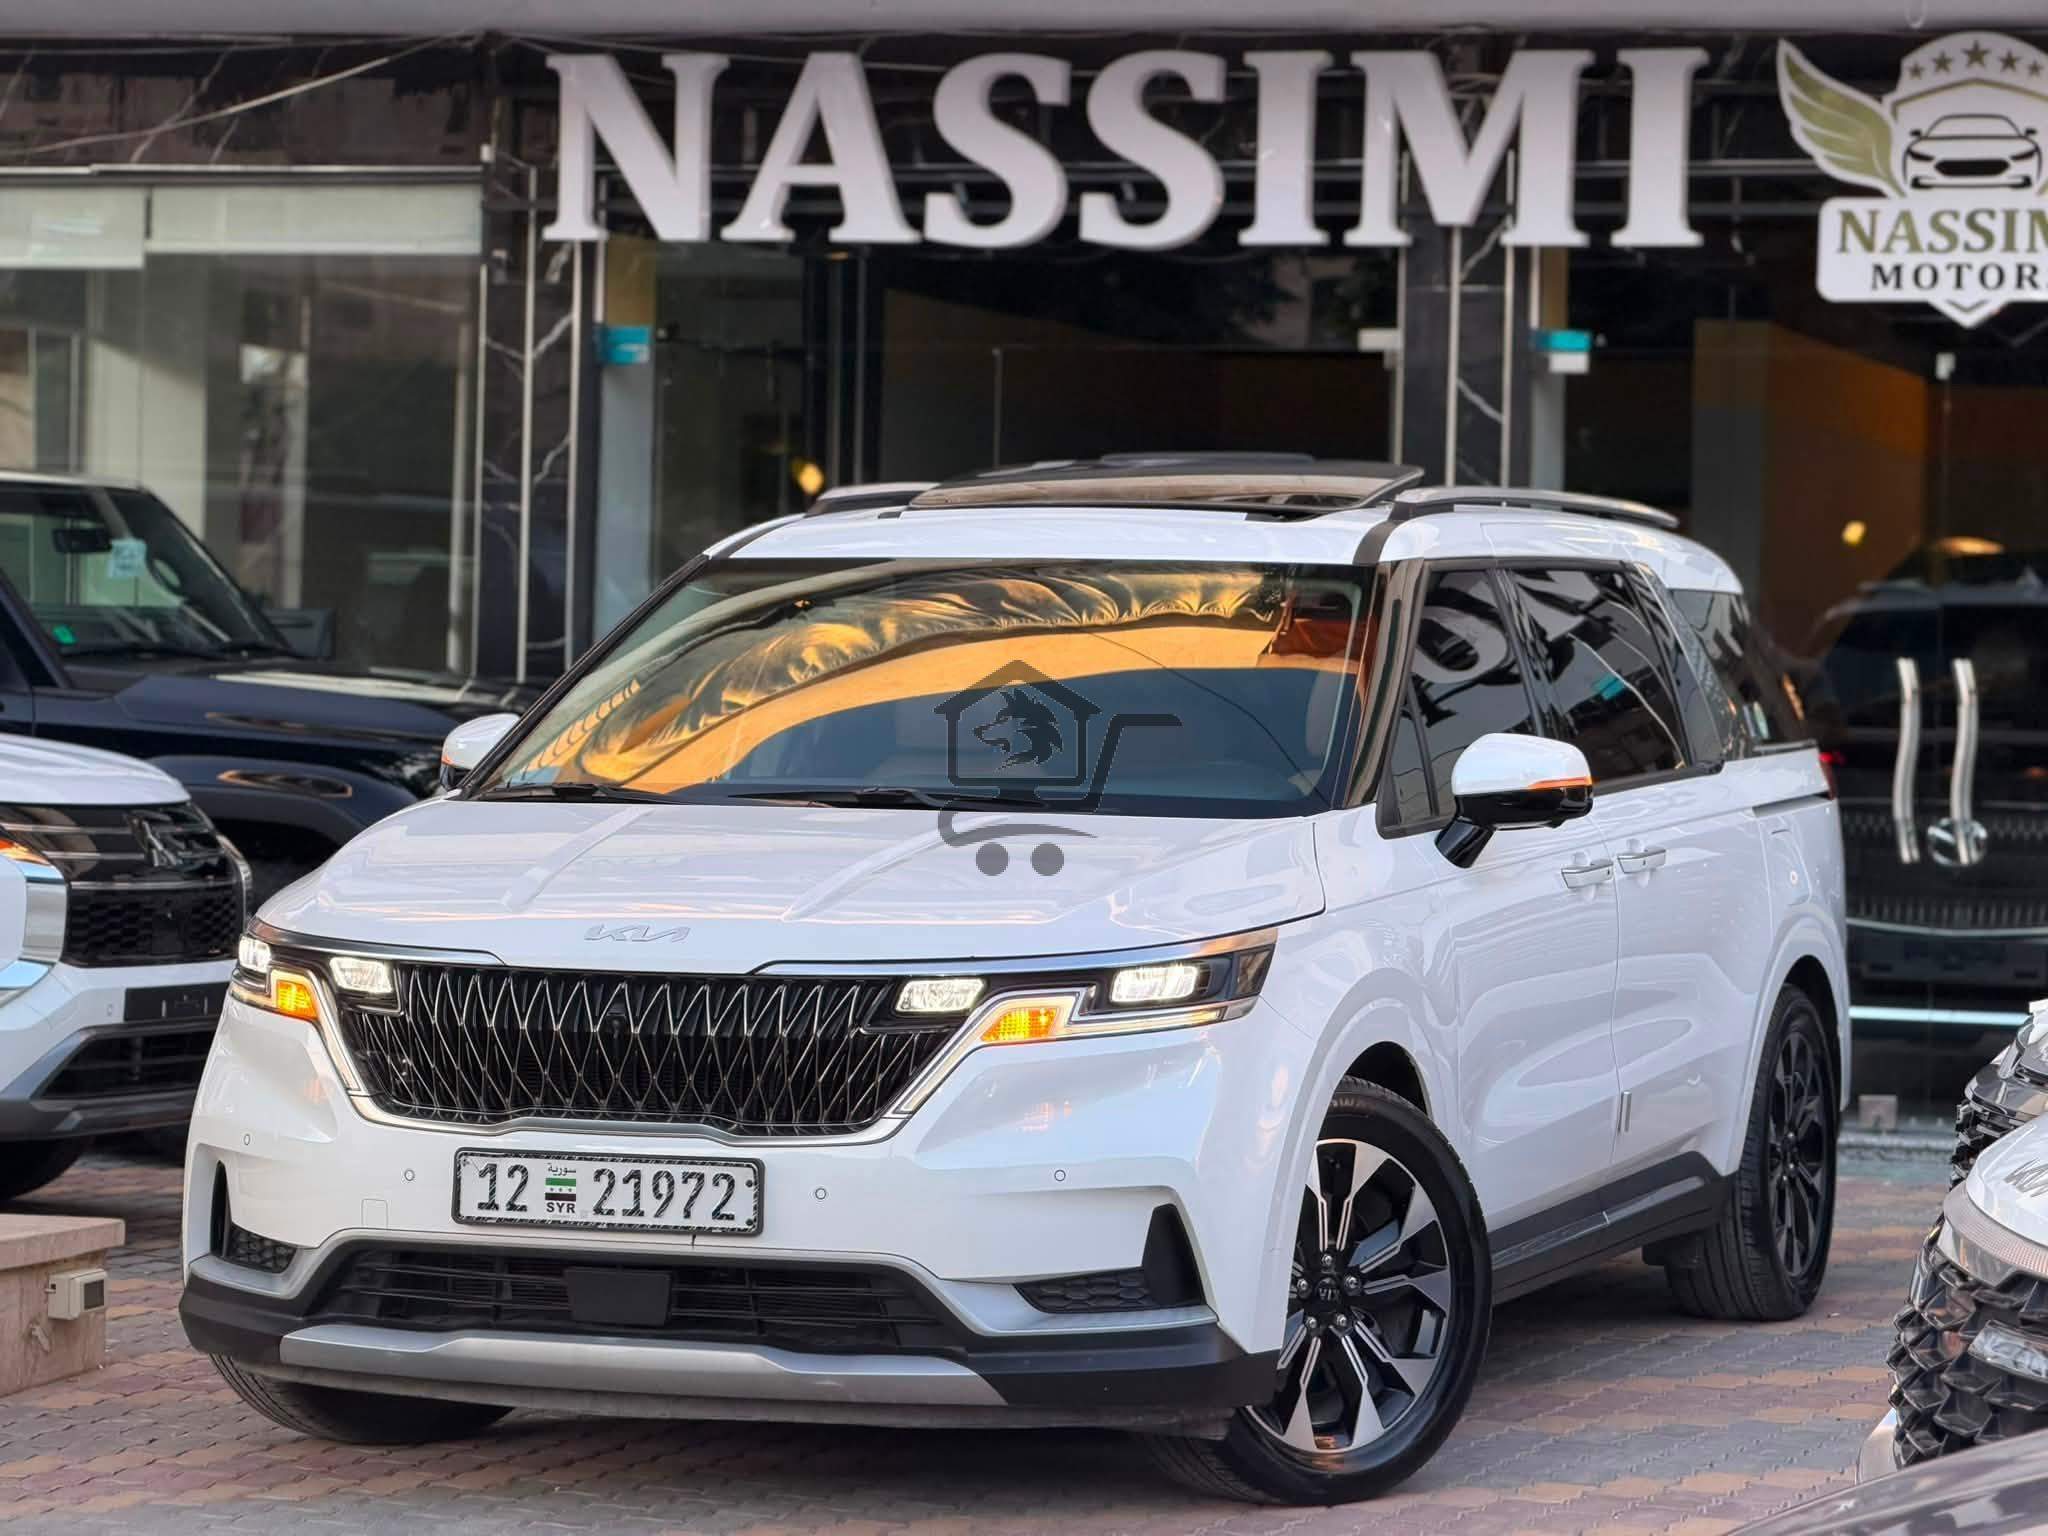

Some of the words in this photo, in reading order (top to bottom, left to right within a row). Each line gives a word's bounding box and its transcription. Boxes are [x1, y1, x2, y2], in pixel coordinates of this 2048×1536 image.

[542, 48, 1709, 250] NASSIMI
[1871, 262, 2048, 290] MOTOR
[548, 1162, 576, 1176] سورية
[477, 1163, 529, 1212] 12
[592, 1168, 736, 1221] 21972
[546, 1201, 576, 1213] SYR
